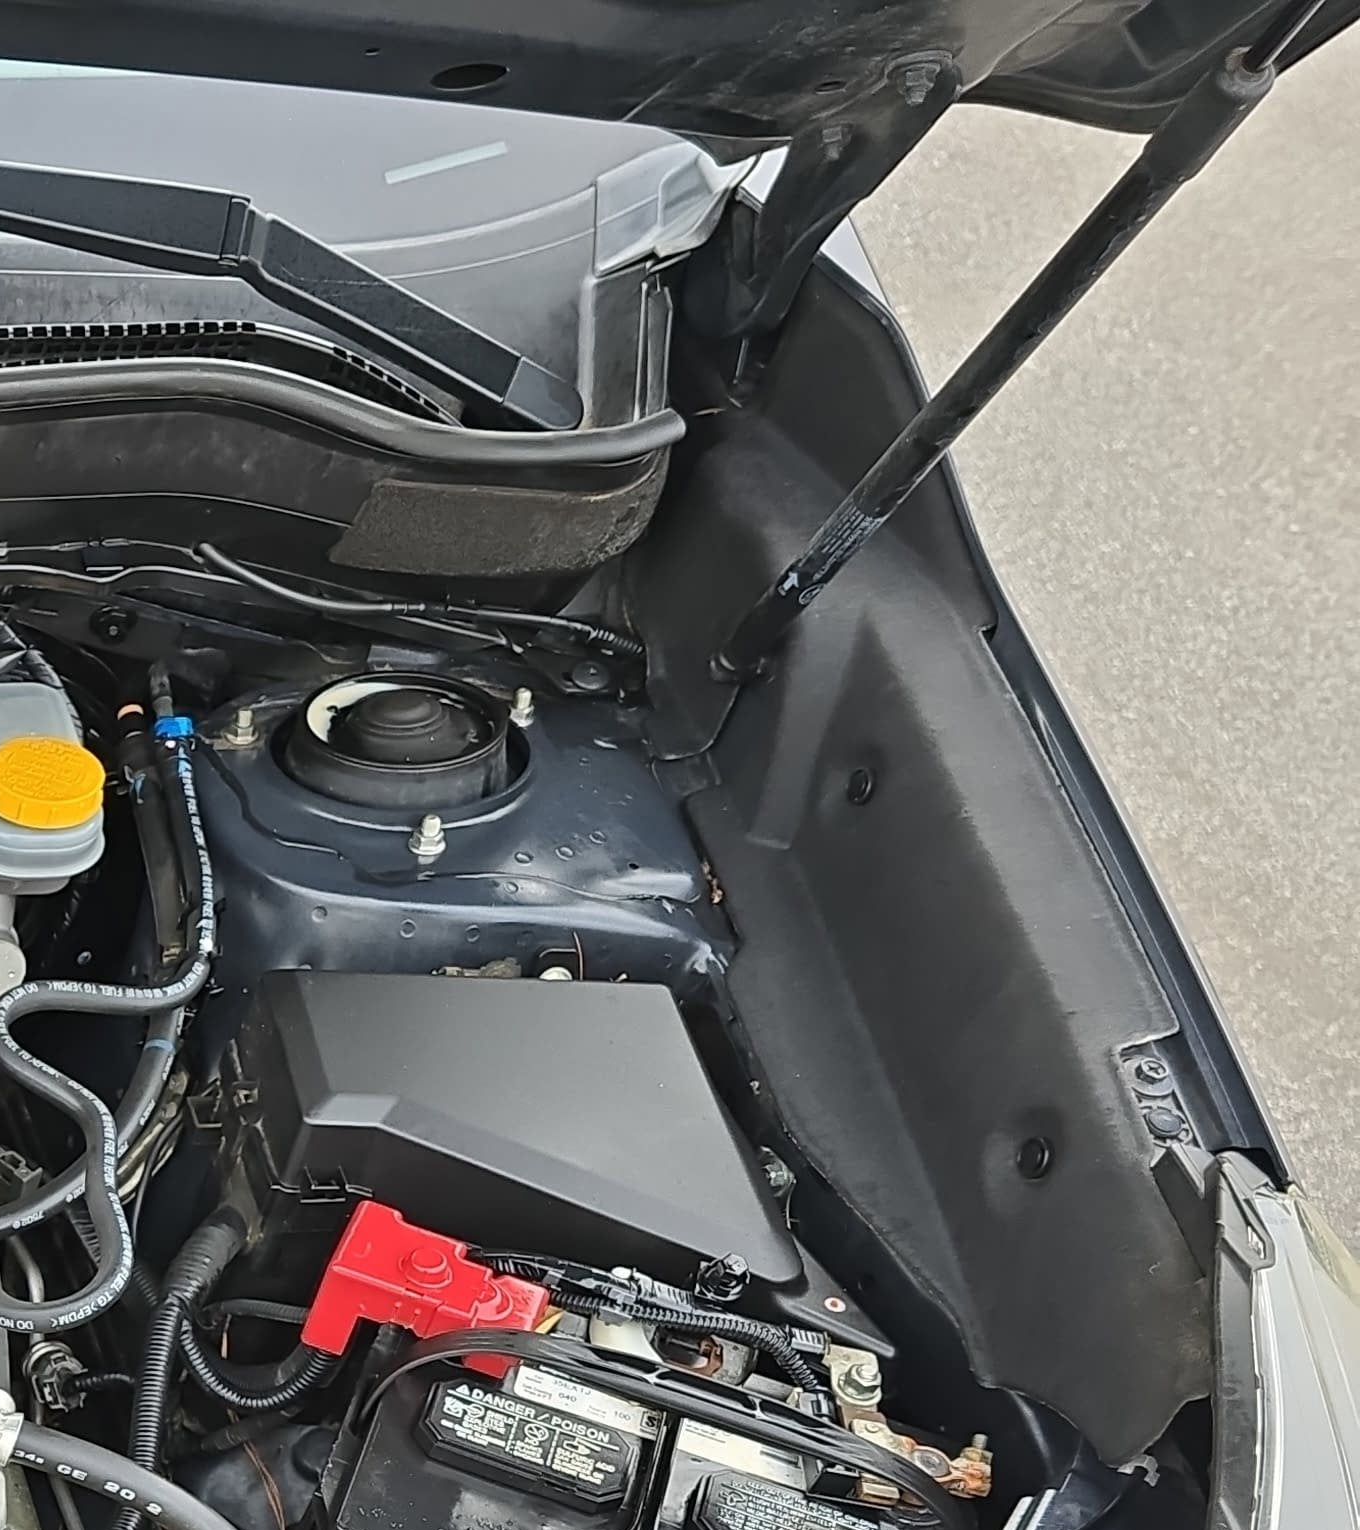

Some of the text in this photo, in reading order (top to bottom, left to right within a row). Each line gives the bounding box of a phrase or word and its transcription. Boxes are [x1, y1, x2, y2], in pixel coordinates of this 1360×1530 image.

[471, 1388, 535, 1421] DANGER
[551, 1416, 610, 1443] POISON
[56, 1463, 88, 1482] GE
[102, 1481, 137, 1501] 20
